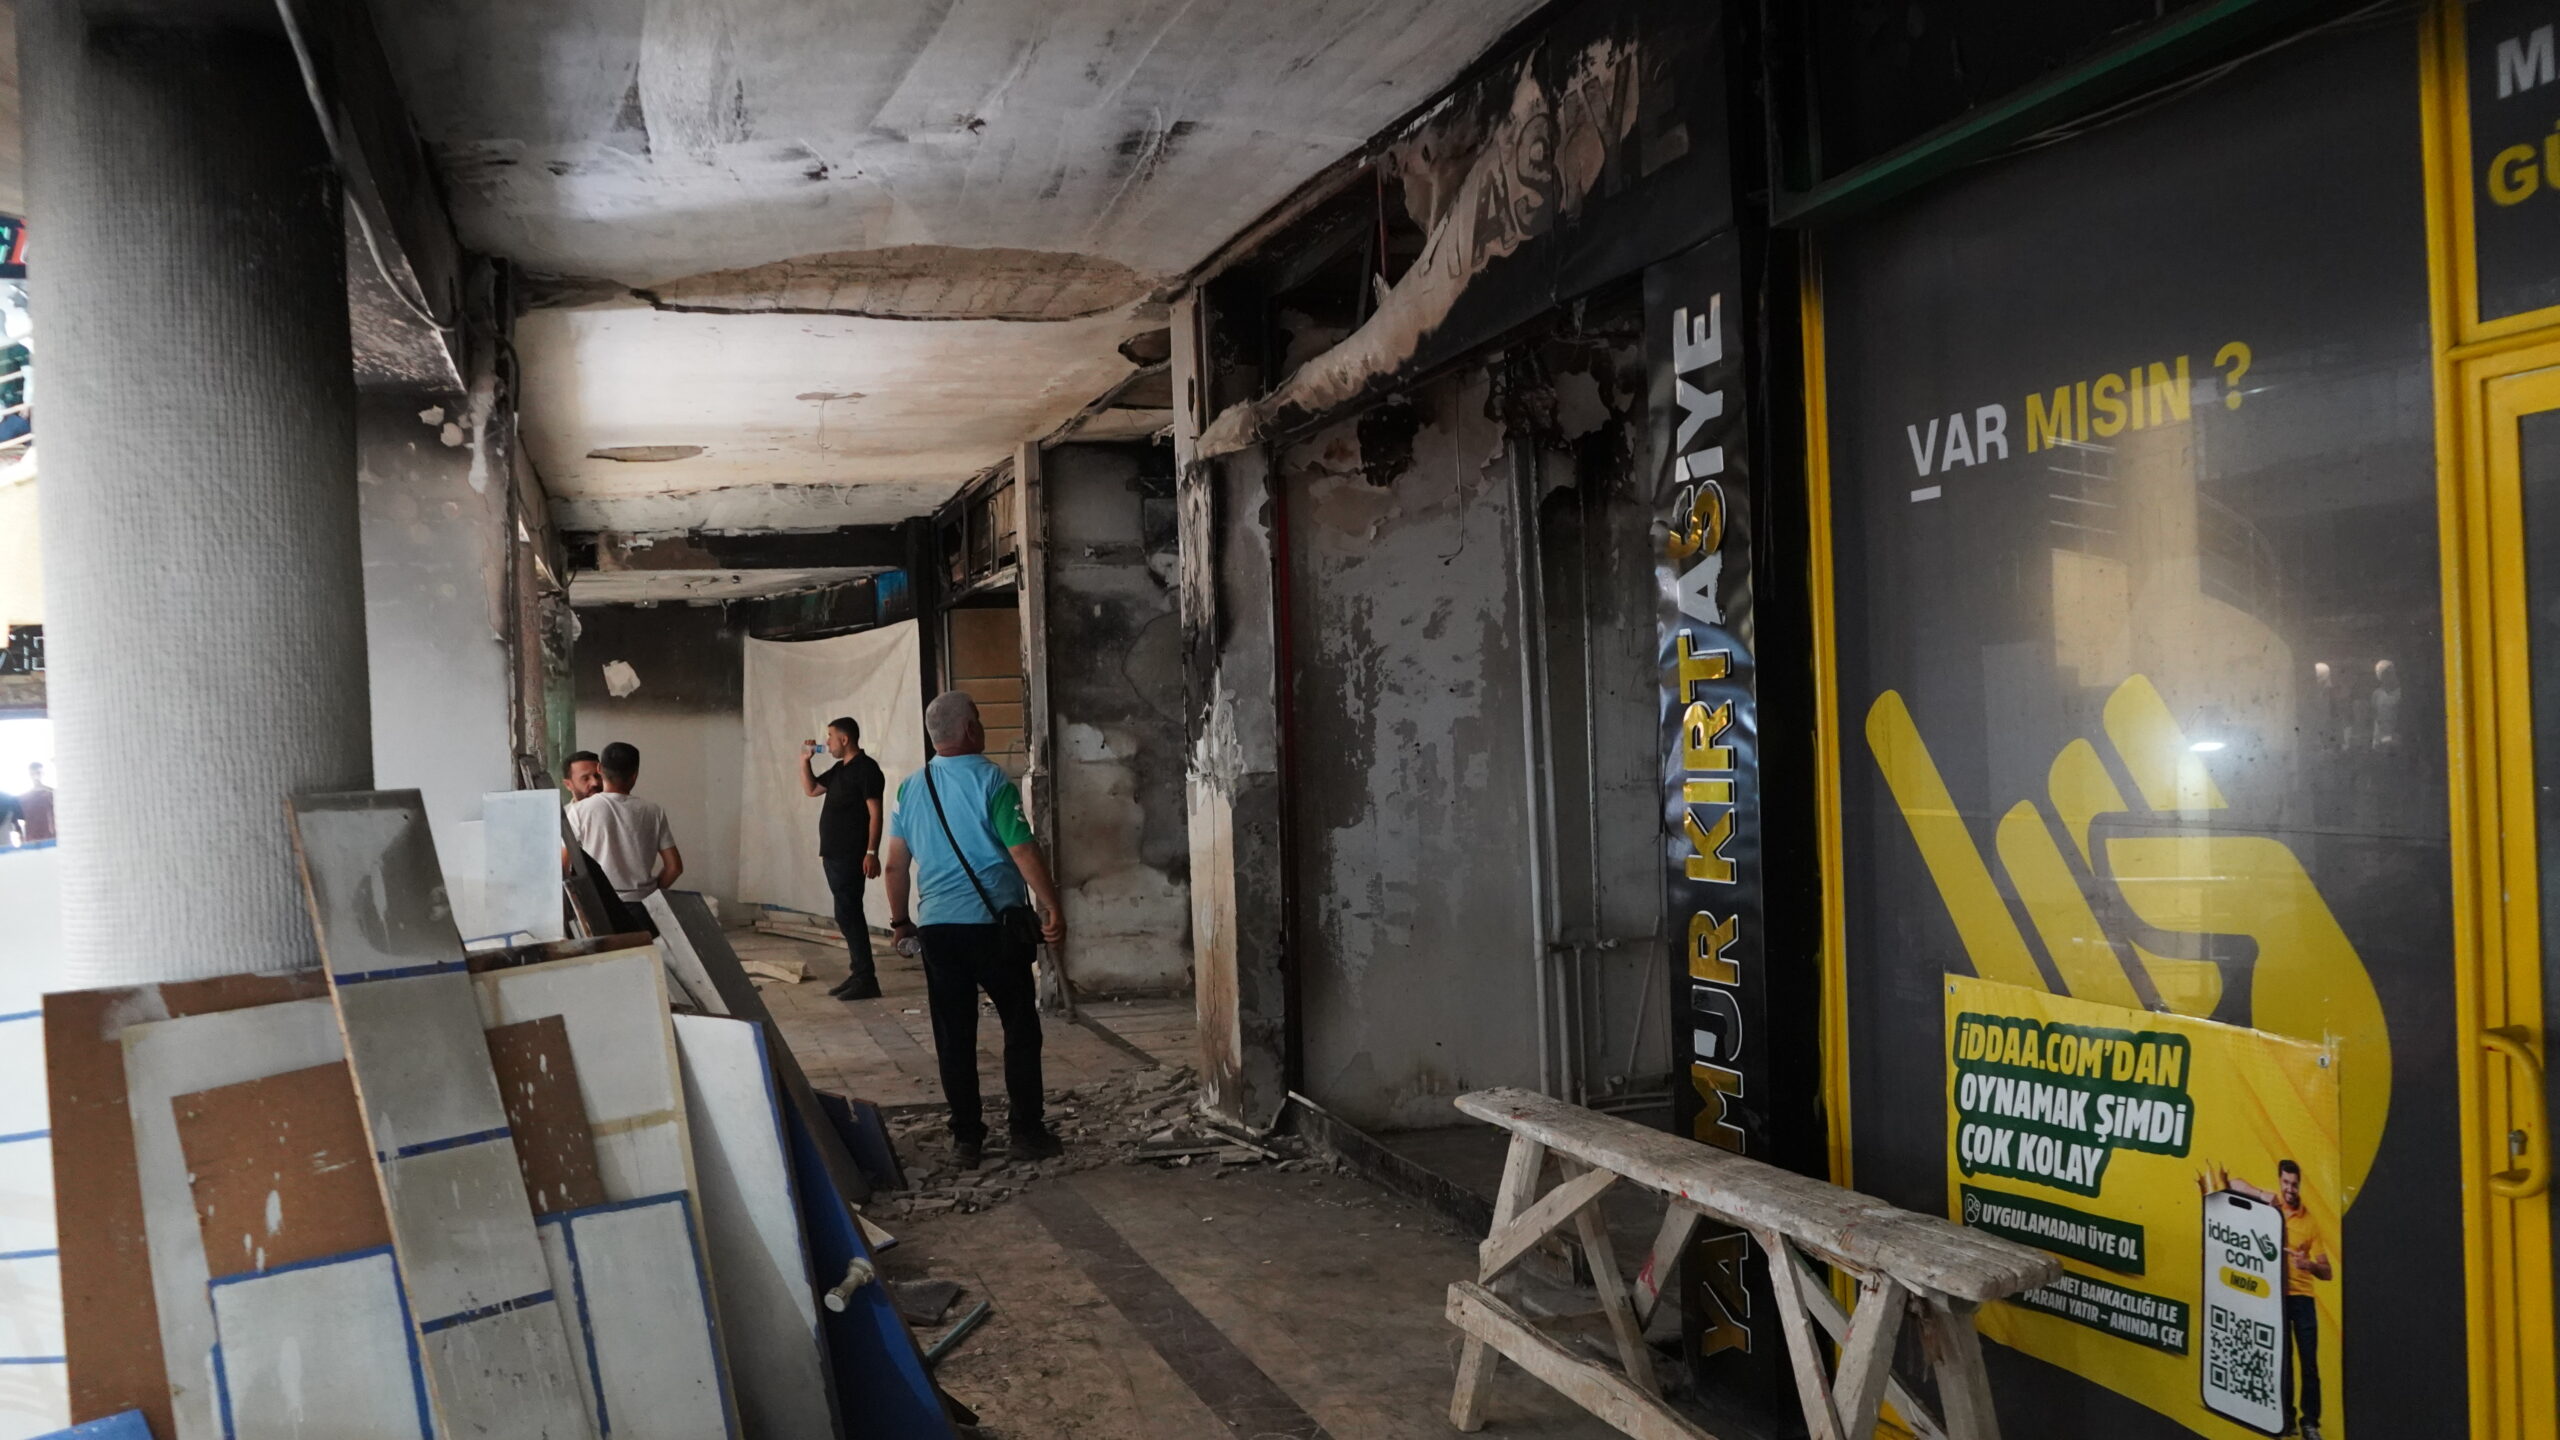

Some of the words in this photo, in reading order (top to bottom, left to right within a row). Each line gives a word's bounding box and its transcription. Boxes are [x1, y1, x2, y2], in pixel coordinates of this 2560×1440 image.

[2497, 23, 2560, 99] M
[1907, 403, 2009, 477] VAR
[2026, 355, 2191, 454] MISIN
[2213, 341, 2252, 410] ?
[1688, 910, 1751, 1356] YAMUR
[1960, 1074, 2090, 1132] OYNAMAK
[1961, 1124, 2010, 1168] ÇOK
[2017, 1137, 2104, 1188] KOLAY
[1982, 1203, 2086, 1247] UYGULAMADAN
[2088, 1225, 2116, 1255] ÜYE
[2118, 1237, 2138, 1260] OL
[2208, 1218, 2251, 1251] iddaa
[2225, 1248, 2264, 1273] com
[2023, 1287, 2068, 1311] PARANI
[2069, 1298, 2099, 1323] YATIR
[2110, 1312, 2158, 1340] ANINDA
[2160, 1325, 2185, 1348] ÇEK
